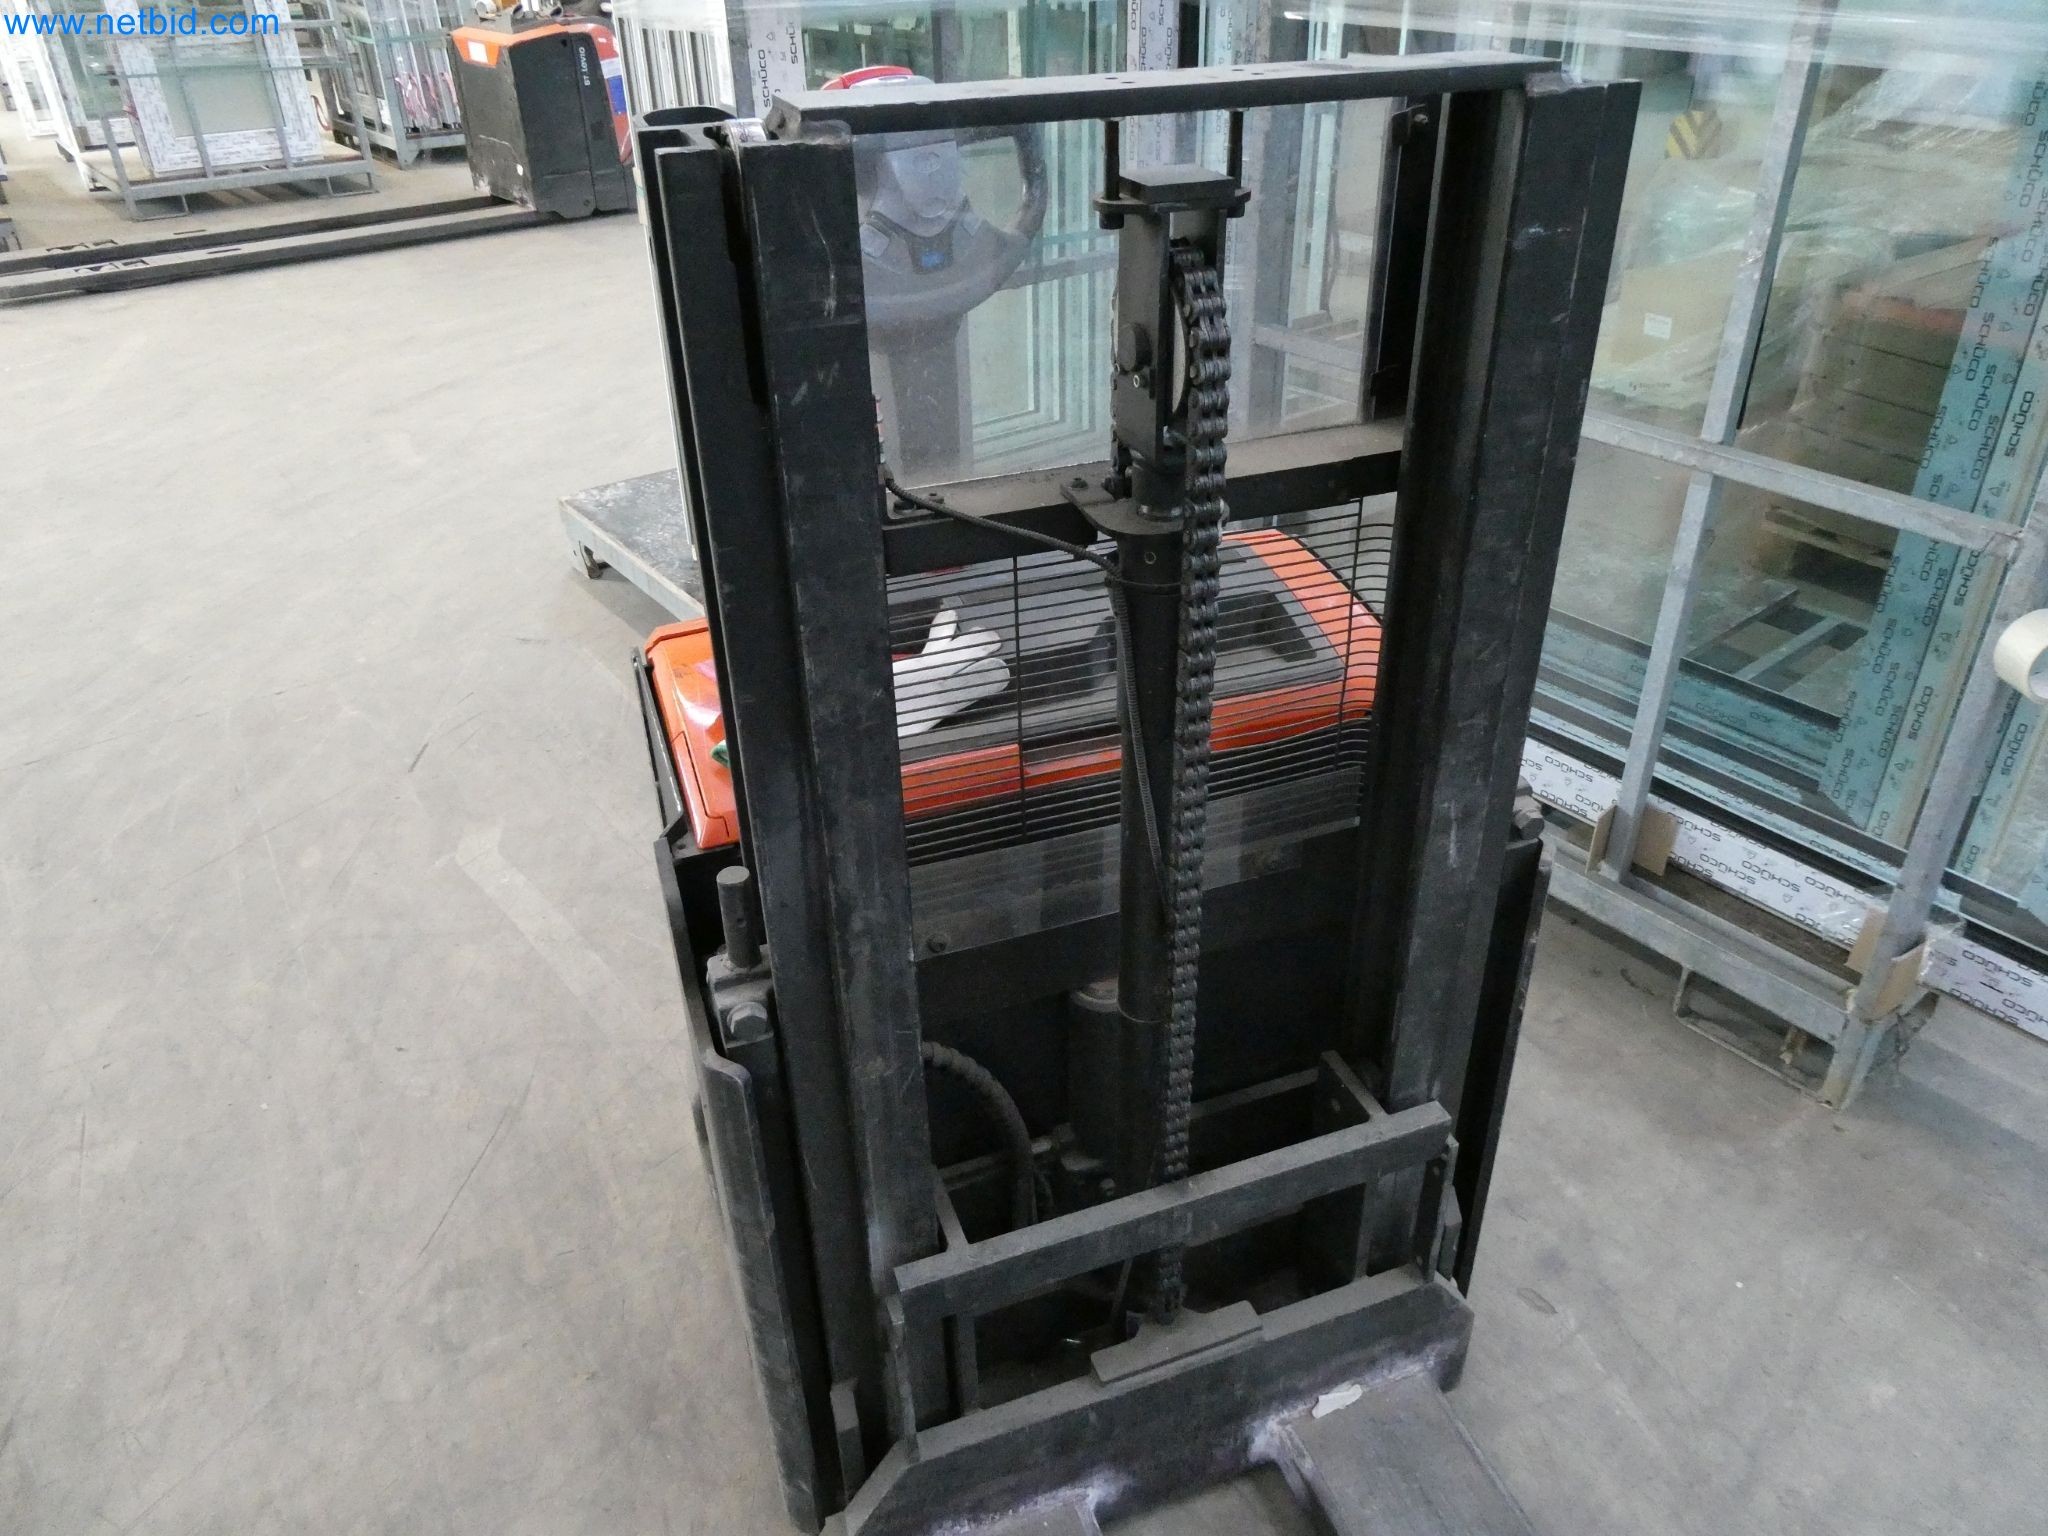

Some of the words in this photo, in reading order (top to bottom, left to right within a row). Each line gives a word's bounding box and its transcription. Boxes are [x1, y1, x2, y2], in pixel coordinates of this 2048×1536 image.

[758, 49, 771, 108] SCHÜCO
[1966, 312, 1994, 381] SCHÜCO
[1968, 364, 1997, 431] SCHÜCO
[2004, 391, 2035, 458] SCHÜCO
[1970, 415, 1999, 480] SCHÜCO
[1953, 550, 1982, 607] SCHÜCO
[1872, 618, 1897, 674] SCHÜCO
[1875, 662, 1900, 717] SCHÜCO
[1908, 686, 1933, 740] SCHÜCO
[1545, 755, 1593, 783] SCHÜCO
[2001, 723, 2028, 776] SCHÜCO
[1700, 853, 1756, 885] SCHÜCO
[1742, 860, 1800, 893] SCHÜCO
[1962, 950, 2033, 987] SCHÜCO
